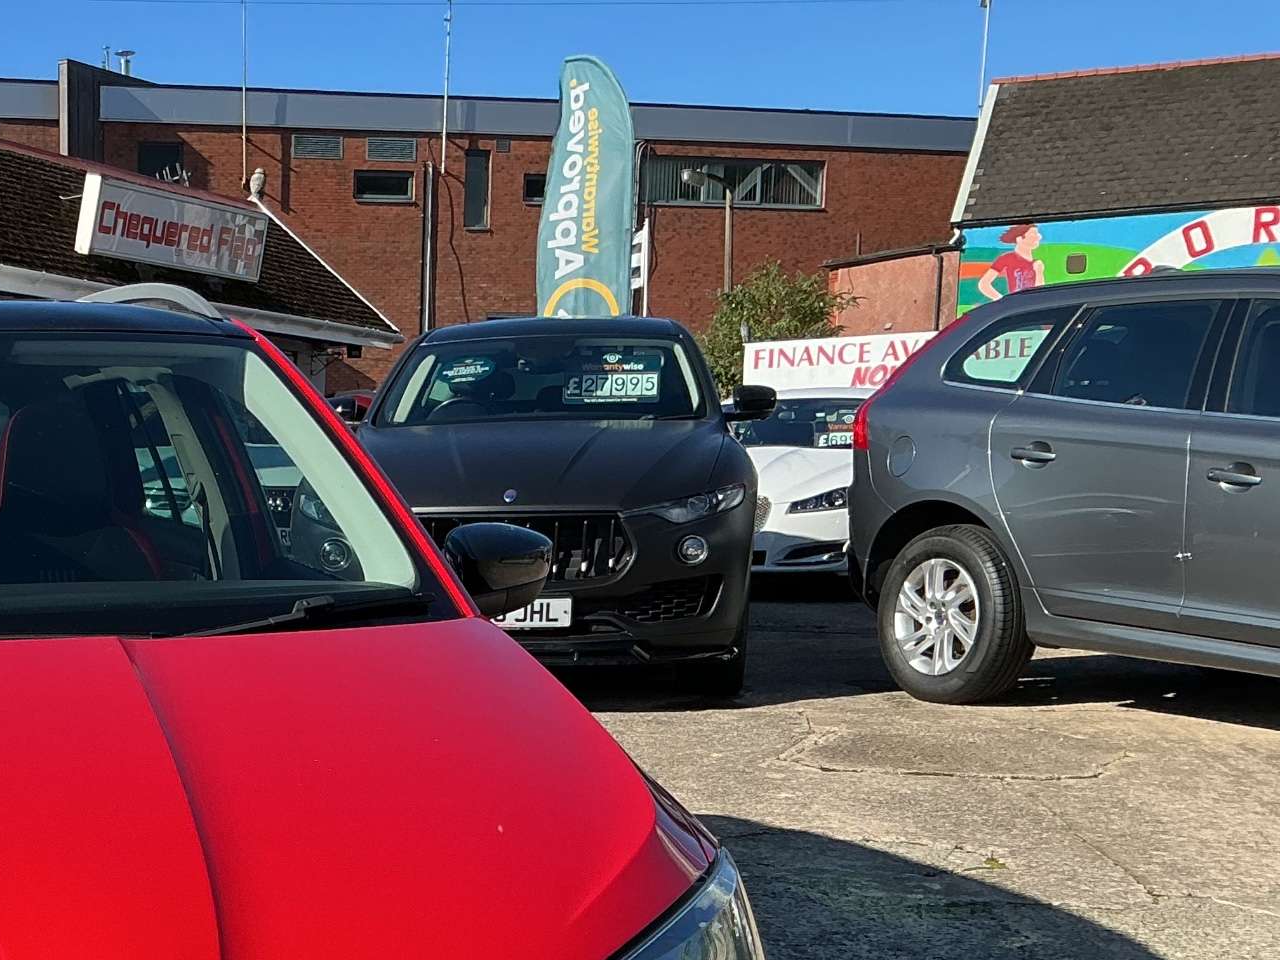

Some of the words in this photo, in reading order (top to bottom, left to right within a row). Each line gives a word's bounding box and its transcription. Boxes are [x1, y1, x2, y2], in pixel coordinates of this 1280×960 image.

[98, 200, 214, 253] Chequered
[219, 225, 261, 268] Flag
[753, 342, 871, 370] FINANCE
[567, 376, 656, 394] £27995
